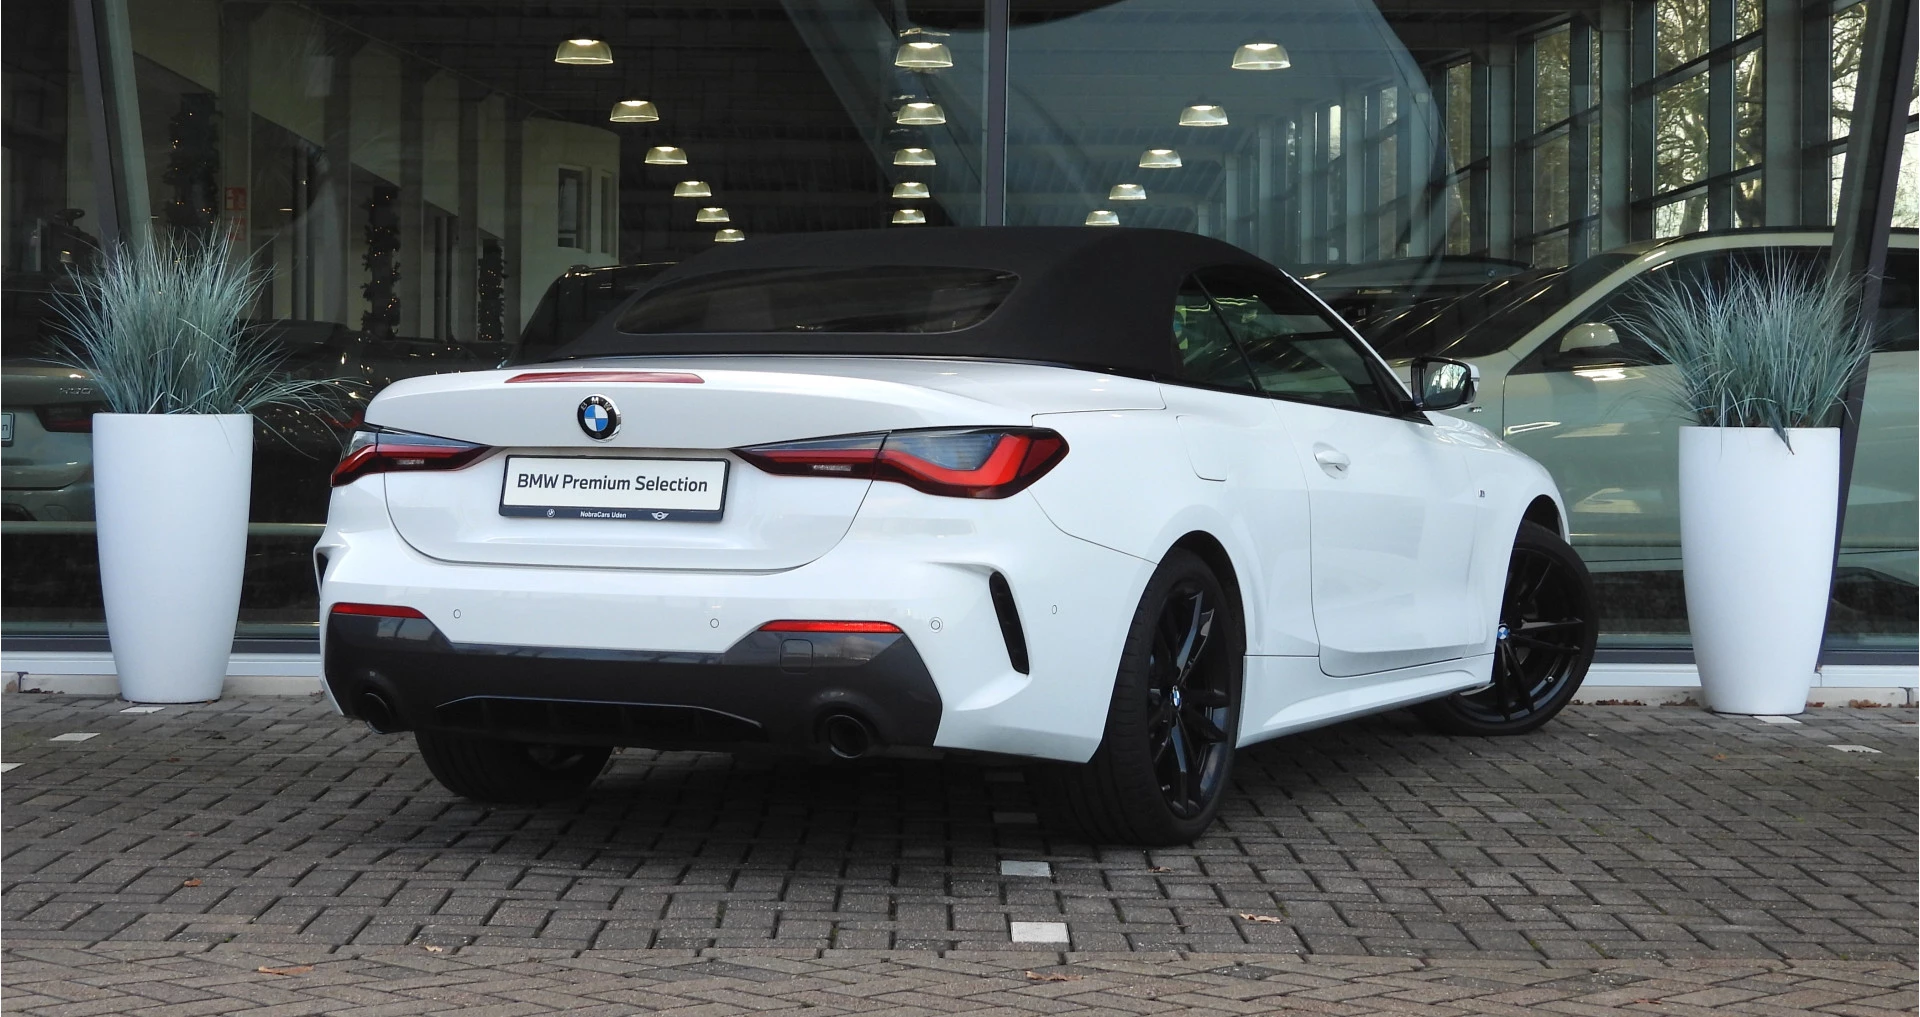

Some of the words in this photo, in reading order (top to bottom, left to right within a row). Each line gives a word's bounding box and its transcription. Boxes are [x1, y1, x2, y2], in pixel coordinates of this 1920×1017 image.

[580, 396, 613, 411] BMW
[517, 473, 559, 489] BMW
[562, 474, 631, 490] Premium
[635, 475, 708, 492] Selection
[611, 511, 627, 519] Uden
